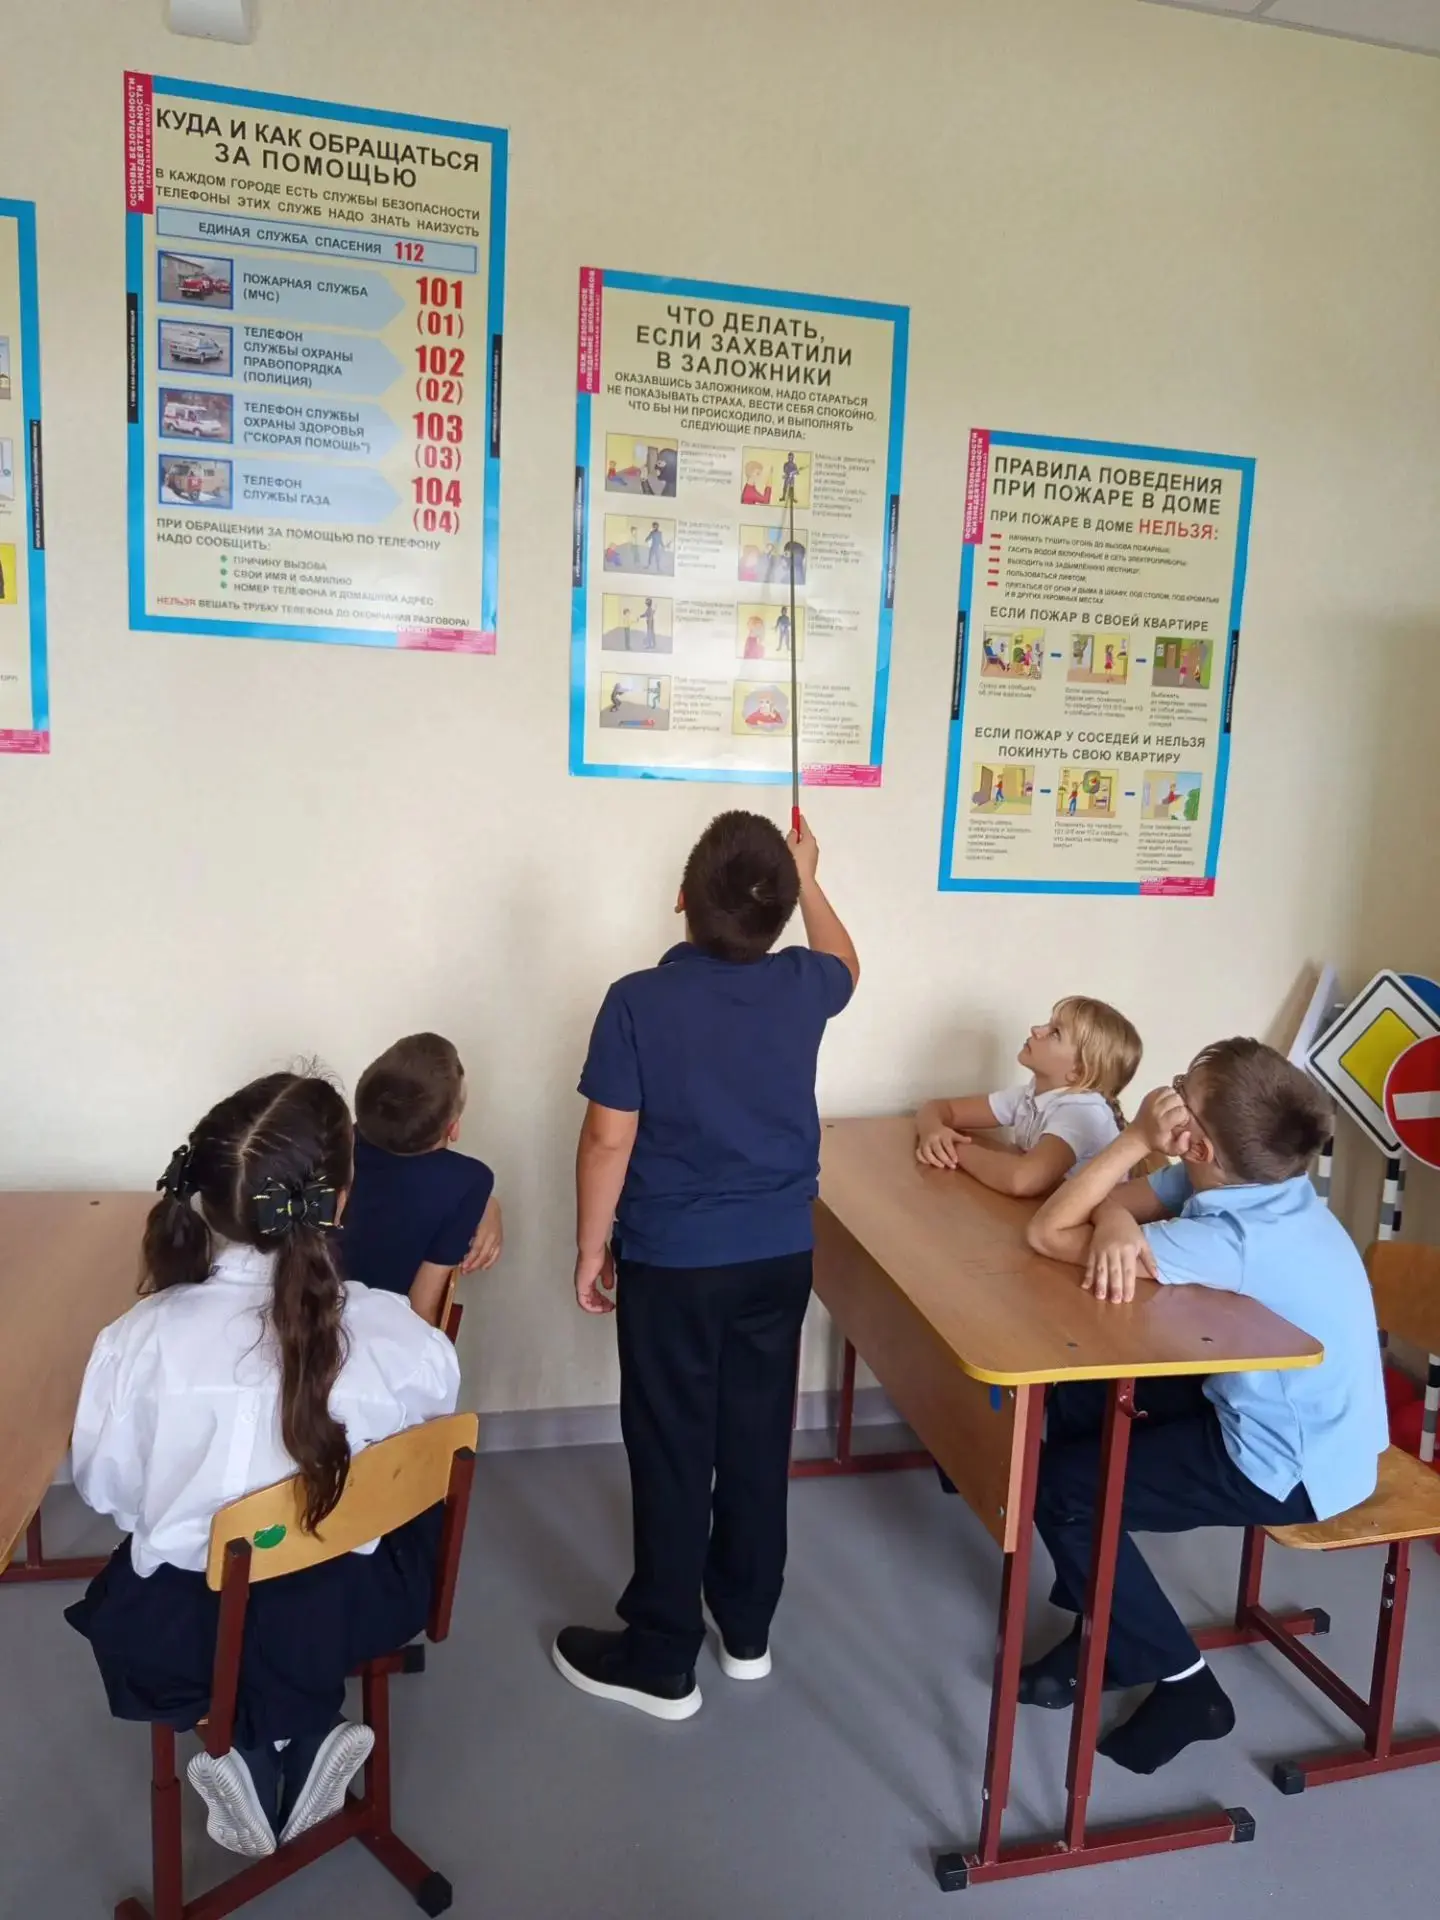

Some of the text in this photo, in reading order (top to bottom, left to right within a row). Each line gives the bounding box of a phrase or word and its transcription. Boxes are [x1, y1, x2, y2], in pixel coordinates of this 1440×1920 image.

[128, 78, 136, 159] БЕЗОПАСНОСТИ
[136, 85, 144, 202] ЖИЗНЕДЕЯТЕЛЬНОСТИ
[157, 108, 478, 172] КУДА И КАК ОБРАЩАТЬСЯ
[215, 143, 416, 187] ЗА ПОМОЩЬЮ
[156, 168, 480, 220] В КАЖДОМ ГОРОДЕ ЕСТЬ СЛУЖБЫ БЕЗОПАСНОСТИ
[156, 186, 479, 237] ТЕЛЕФОНЫ ЭТИХ СЛУЖБ НАДО ЗНАТЬ НАИЗУСТЬ
[199, 222, 424, 262] ЕДИНАЯ СЛУЖБА СПАСЕНИЯ 112
[243, 273, 367, 297] ПОЖАРНАЯ СЛУЖБА
[243, 288, 279, 303] (МЧС)
[416, 278, 463, 309] 101
[244, 328, 303, 342] ТЕЛЕФОН
[416, 310, 463, 339] (01)
[667, 305, 825, 342] ЧТО ДЕЛАТЬ,
[244, 342, 353, 362] СЛУЖБЫ ОХРАНЫ
[636, 325, 852, 366] ЕСЛИ ЗАХВАТИЛИ
[244, 357, 341, 376] ПРАВОПОРЯДКА
[415, 346, 465, 377] 102
[657, 352, 831, 386] В ЗАЛОЖНИКИ
[244, 371, 312, 388] (ПОЛИЦИЯ)
[416, 378, 463, 404] (02)
[615, 372, 867, 406] ОКАЗАВШИСЬ ЗАЛОЖНИКОМ, НАДО СТАРАТЬСЯ
[244, 403, 359, 422] ТЕЛЕФОН СЛУЖБЫ
[607, 385, 622, 396] НЕ
[625, 386, 699, 403] ПОКАЗЫВАТЬ
[749, 400, 783, 412] ВЕСТИ
[786, 403, 814, 415] СЕБЯ
[244, 417, 364, 438] ОХРАНЫ ЗДОРОВЬЯ
[412, 412, 463, 443] 103
[629, 401, 649, 411] ЧТО
[653, 403, 670, 414] БЫ
[673, 405, 689, 415] НИ
[778, 415, 785, 424] И
[787, 416, 853, 432] ВЫПОЛНЯТЬ
[681, 419, 750, 436] СЛЕДУЮЩИЕ
[415, 444, 462, 471] (03)
[243, 475, 302, 489] ТЕЛЕФОН
[995, 457, 1091, 481] ПРАВИЛА
[1100, 467, 1222, 494] ПОВЕДЕНИЯ
[243, 488, 330, 506] СЛУЖБЫ ГАЗА
[412, 477, 462, 508] 104
[993, 479, 1220, 515] ПРИ ПОЖАРЕ В ДОМЕ
[157, 518, 440, 550] ПРИ ОБРАЩЕНИИ ЗА ПОМОЩЬЮ ПО ТЕЛЕФОНУ
[413, 509, 460, 534] (04)
[990, 510, 1219, 540] ПРИ ПОЖАРЕ В ДОМЕ НЕЛЬЗЯ:
[157, 533, 271, 550] НАДО СООБЩИТЬ:
[234, 556, 327, 570] ПРИЧИНУ ВЫЗОВА
[265, 572, 287, 580] ИМЯ
[234, 584, 269, 592] НОМЕР
[273, 586, 327, 597] ТЕЛЕФОНА
[157, 596, 196, 606] НЕЛЬЗЯ
[199, 600, 240, 610] ВЕШАТЬ
[243, 602, 278, 612] ТРУБКУ
[336, 610, 349, 618] ДО
[990, 606, 1209, 631] ЕСЛИ ПОЖАР В СВОЕЙ КВАРТИРЕ
[975, 727, 1205, 748] ЕСЛИ ПОЖАР У СОСЕДЕЙ И НЕЛЬЗЯ
[998, 746, 1180, 764] ПОКИНУТЬ СВОЮ КВАРТИРУ
